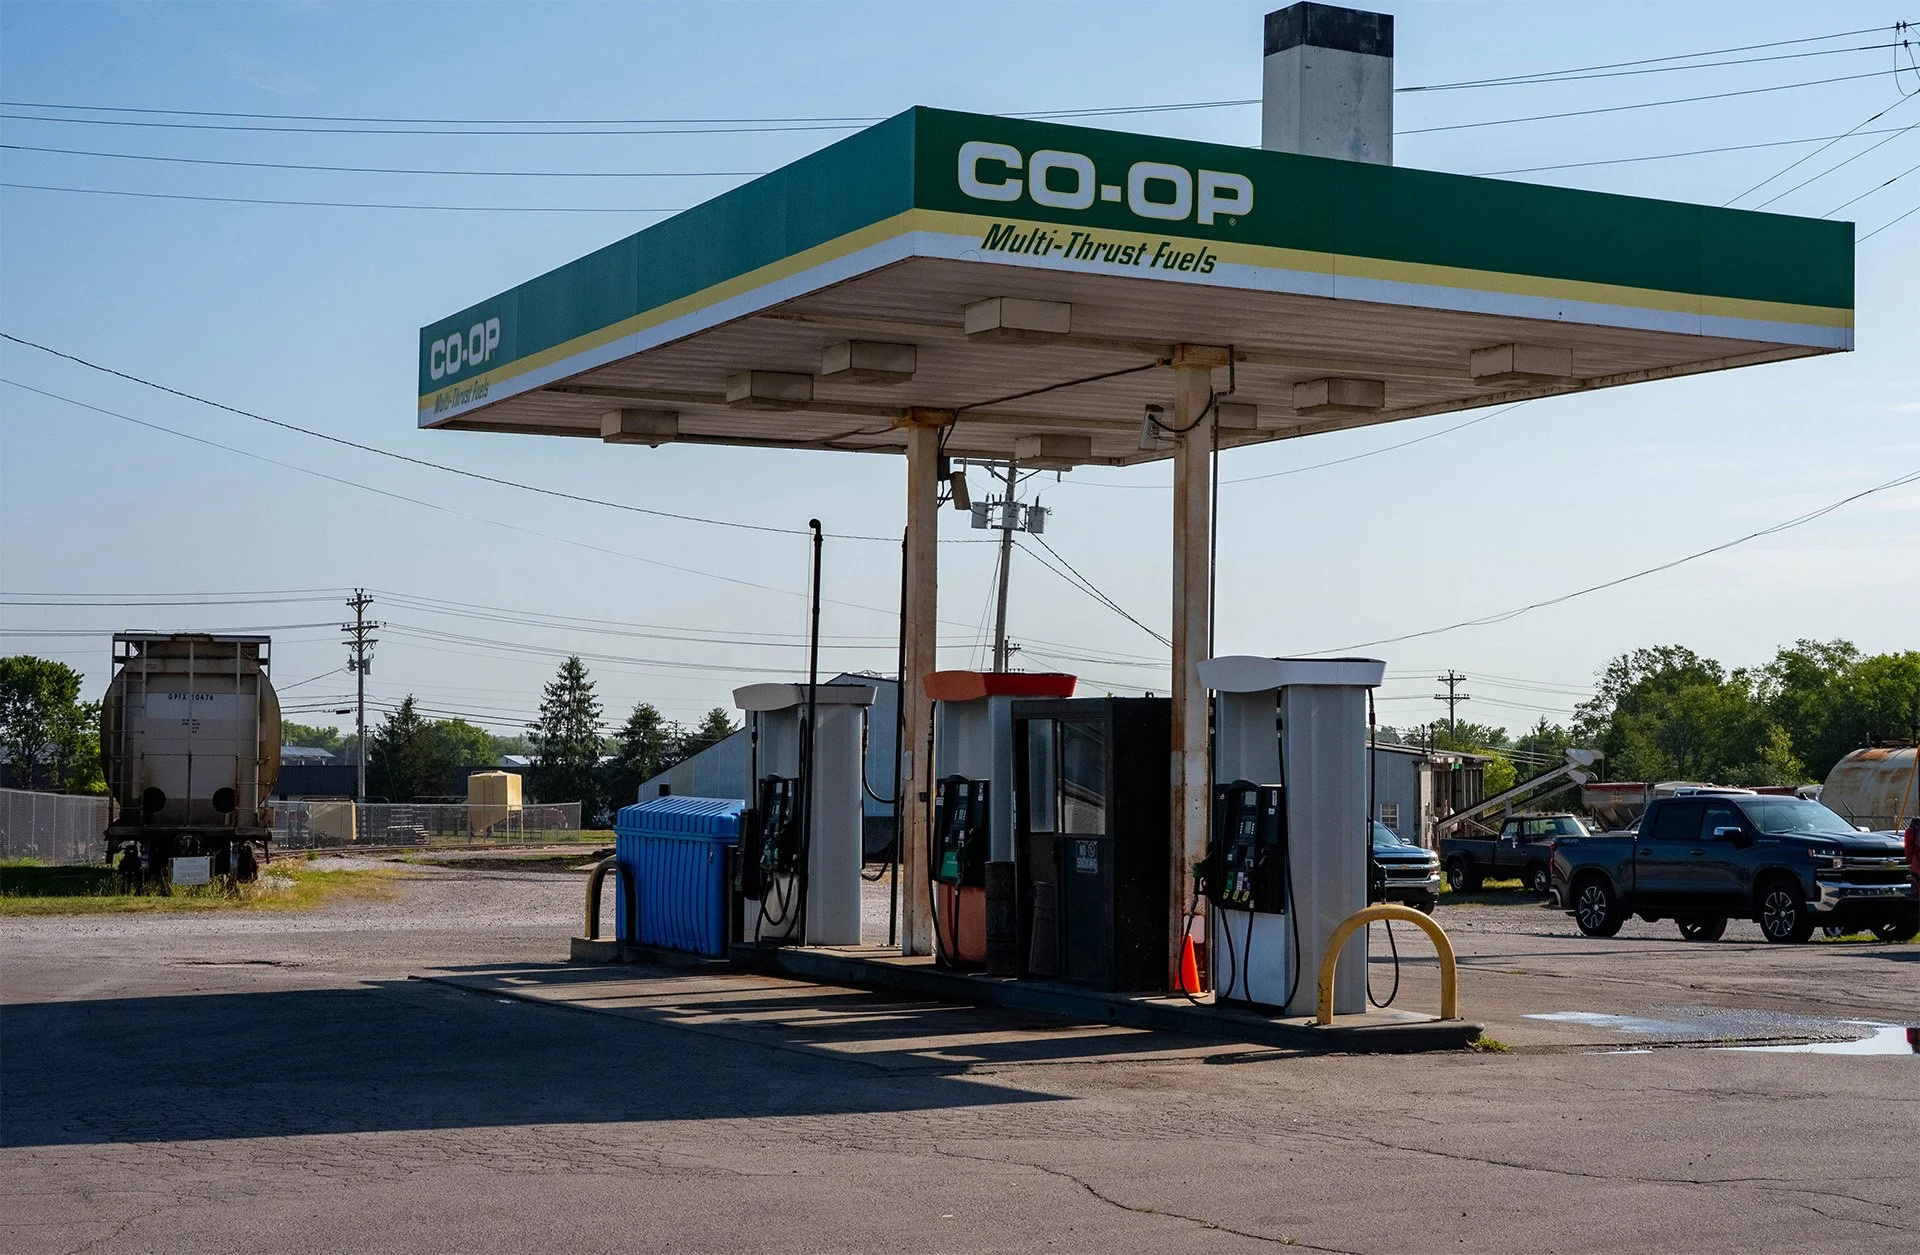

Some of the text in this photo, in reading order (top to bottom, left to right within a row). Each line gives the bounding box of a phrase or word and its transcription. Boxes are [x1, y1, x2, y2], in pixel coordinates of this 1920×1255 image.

[957, 141, 1254, 225] CO-OP
[980, 223, 1217, 274] Multi-Thrust Fuels
[430, 317, 500, 380] CO-OP
